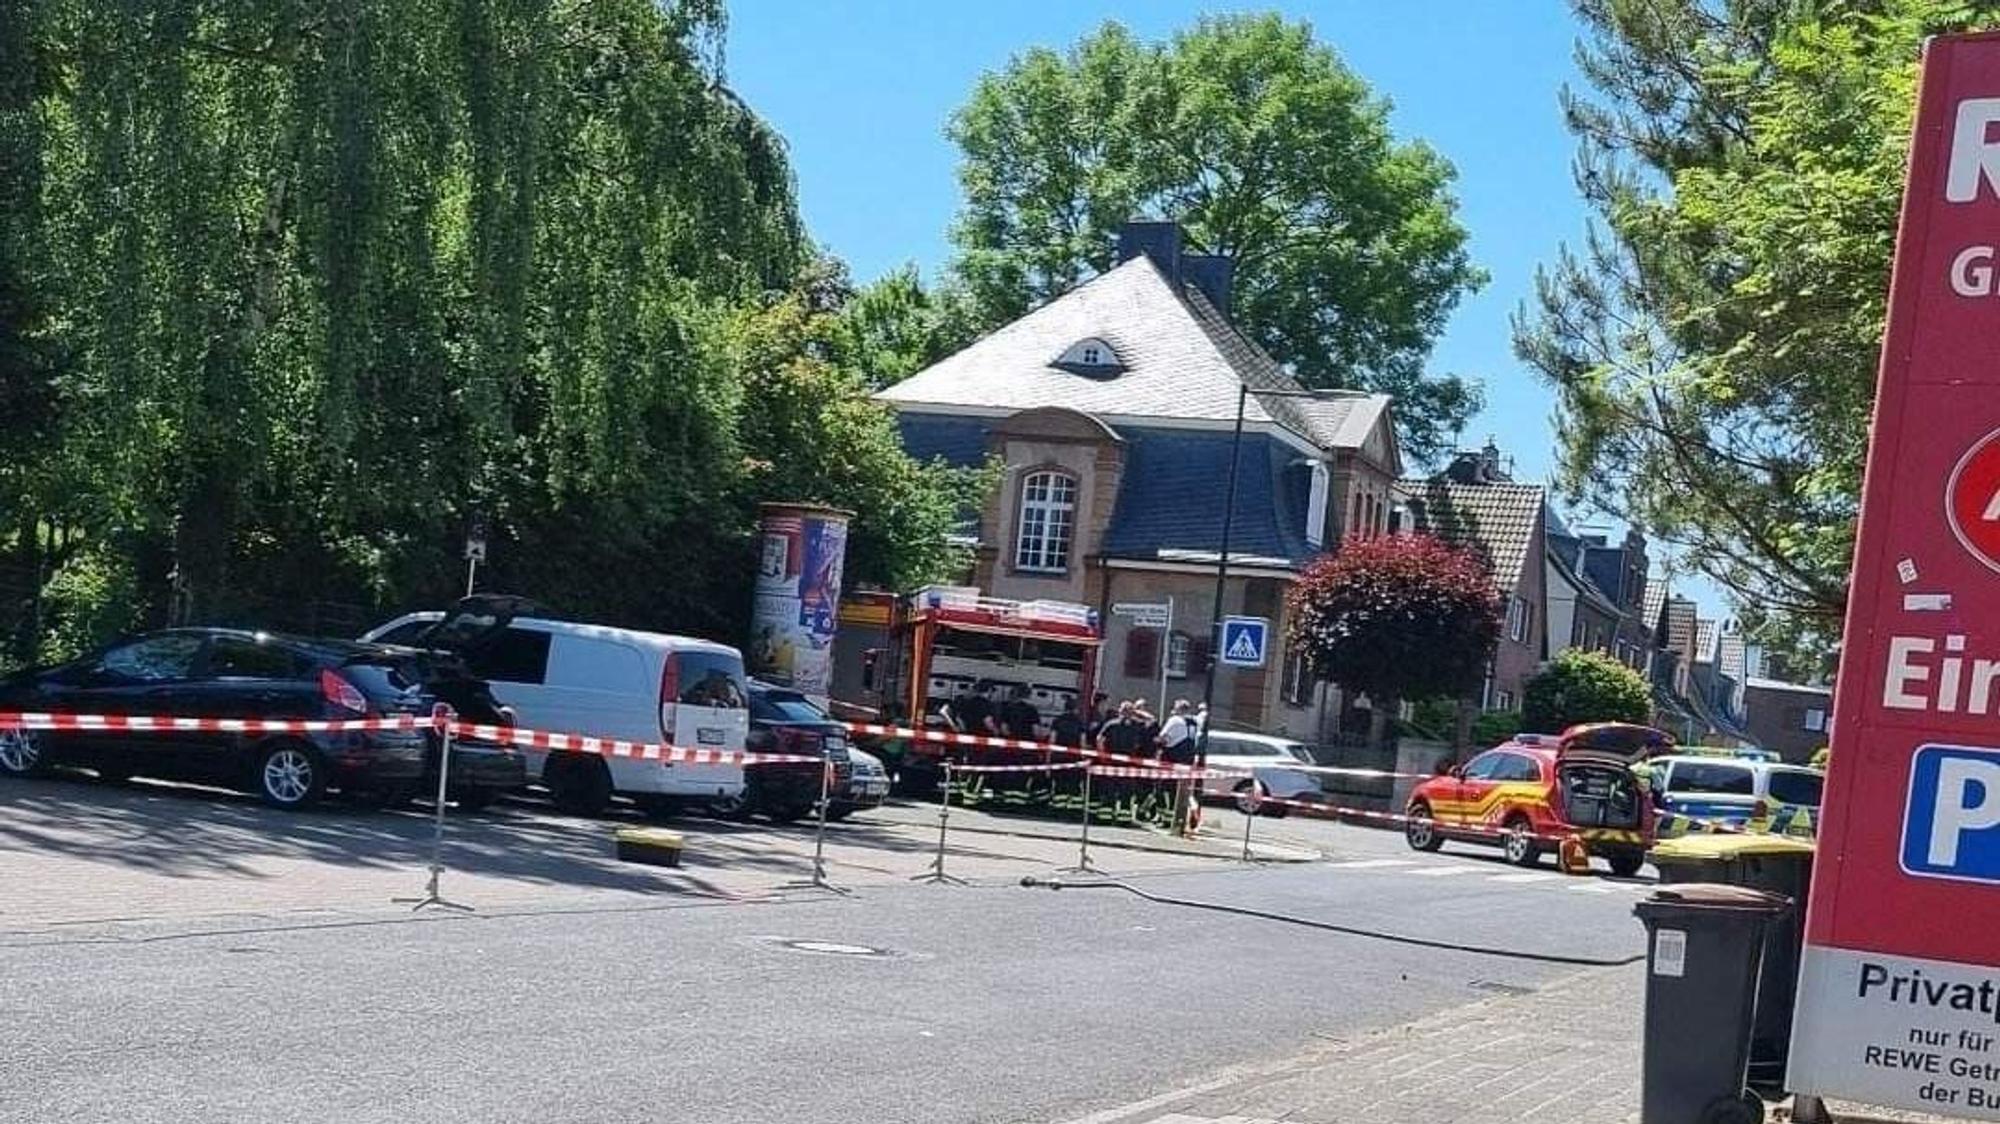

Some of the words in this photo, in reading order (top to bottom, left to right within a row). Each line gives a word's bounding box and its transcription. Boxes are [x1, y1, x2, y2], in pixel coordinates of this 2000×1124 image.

[1946, 98, 2000, 202] R
[1951, 246, 2000, 296] G
[1927, 757, 2000, 867] P
[1909, 1028, 1951, 1047] nur
[1959, 1030, 1994, 1052] für
[1865, 1046, 1942, 1073] REWE
[1919, 1082, 1960, 1103] der
